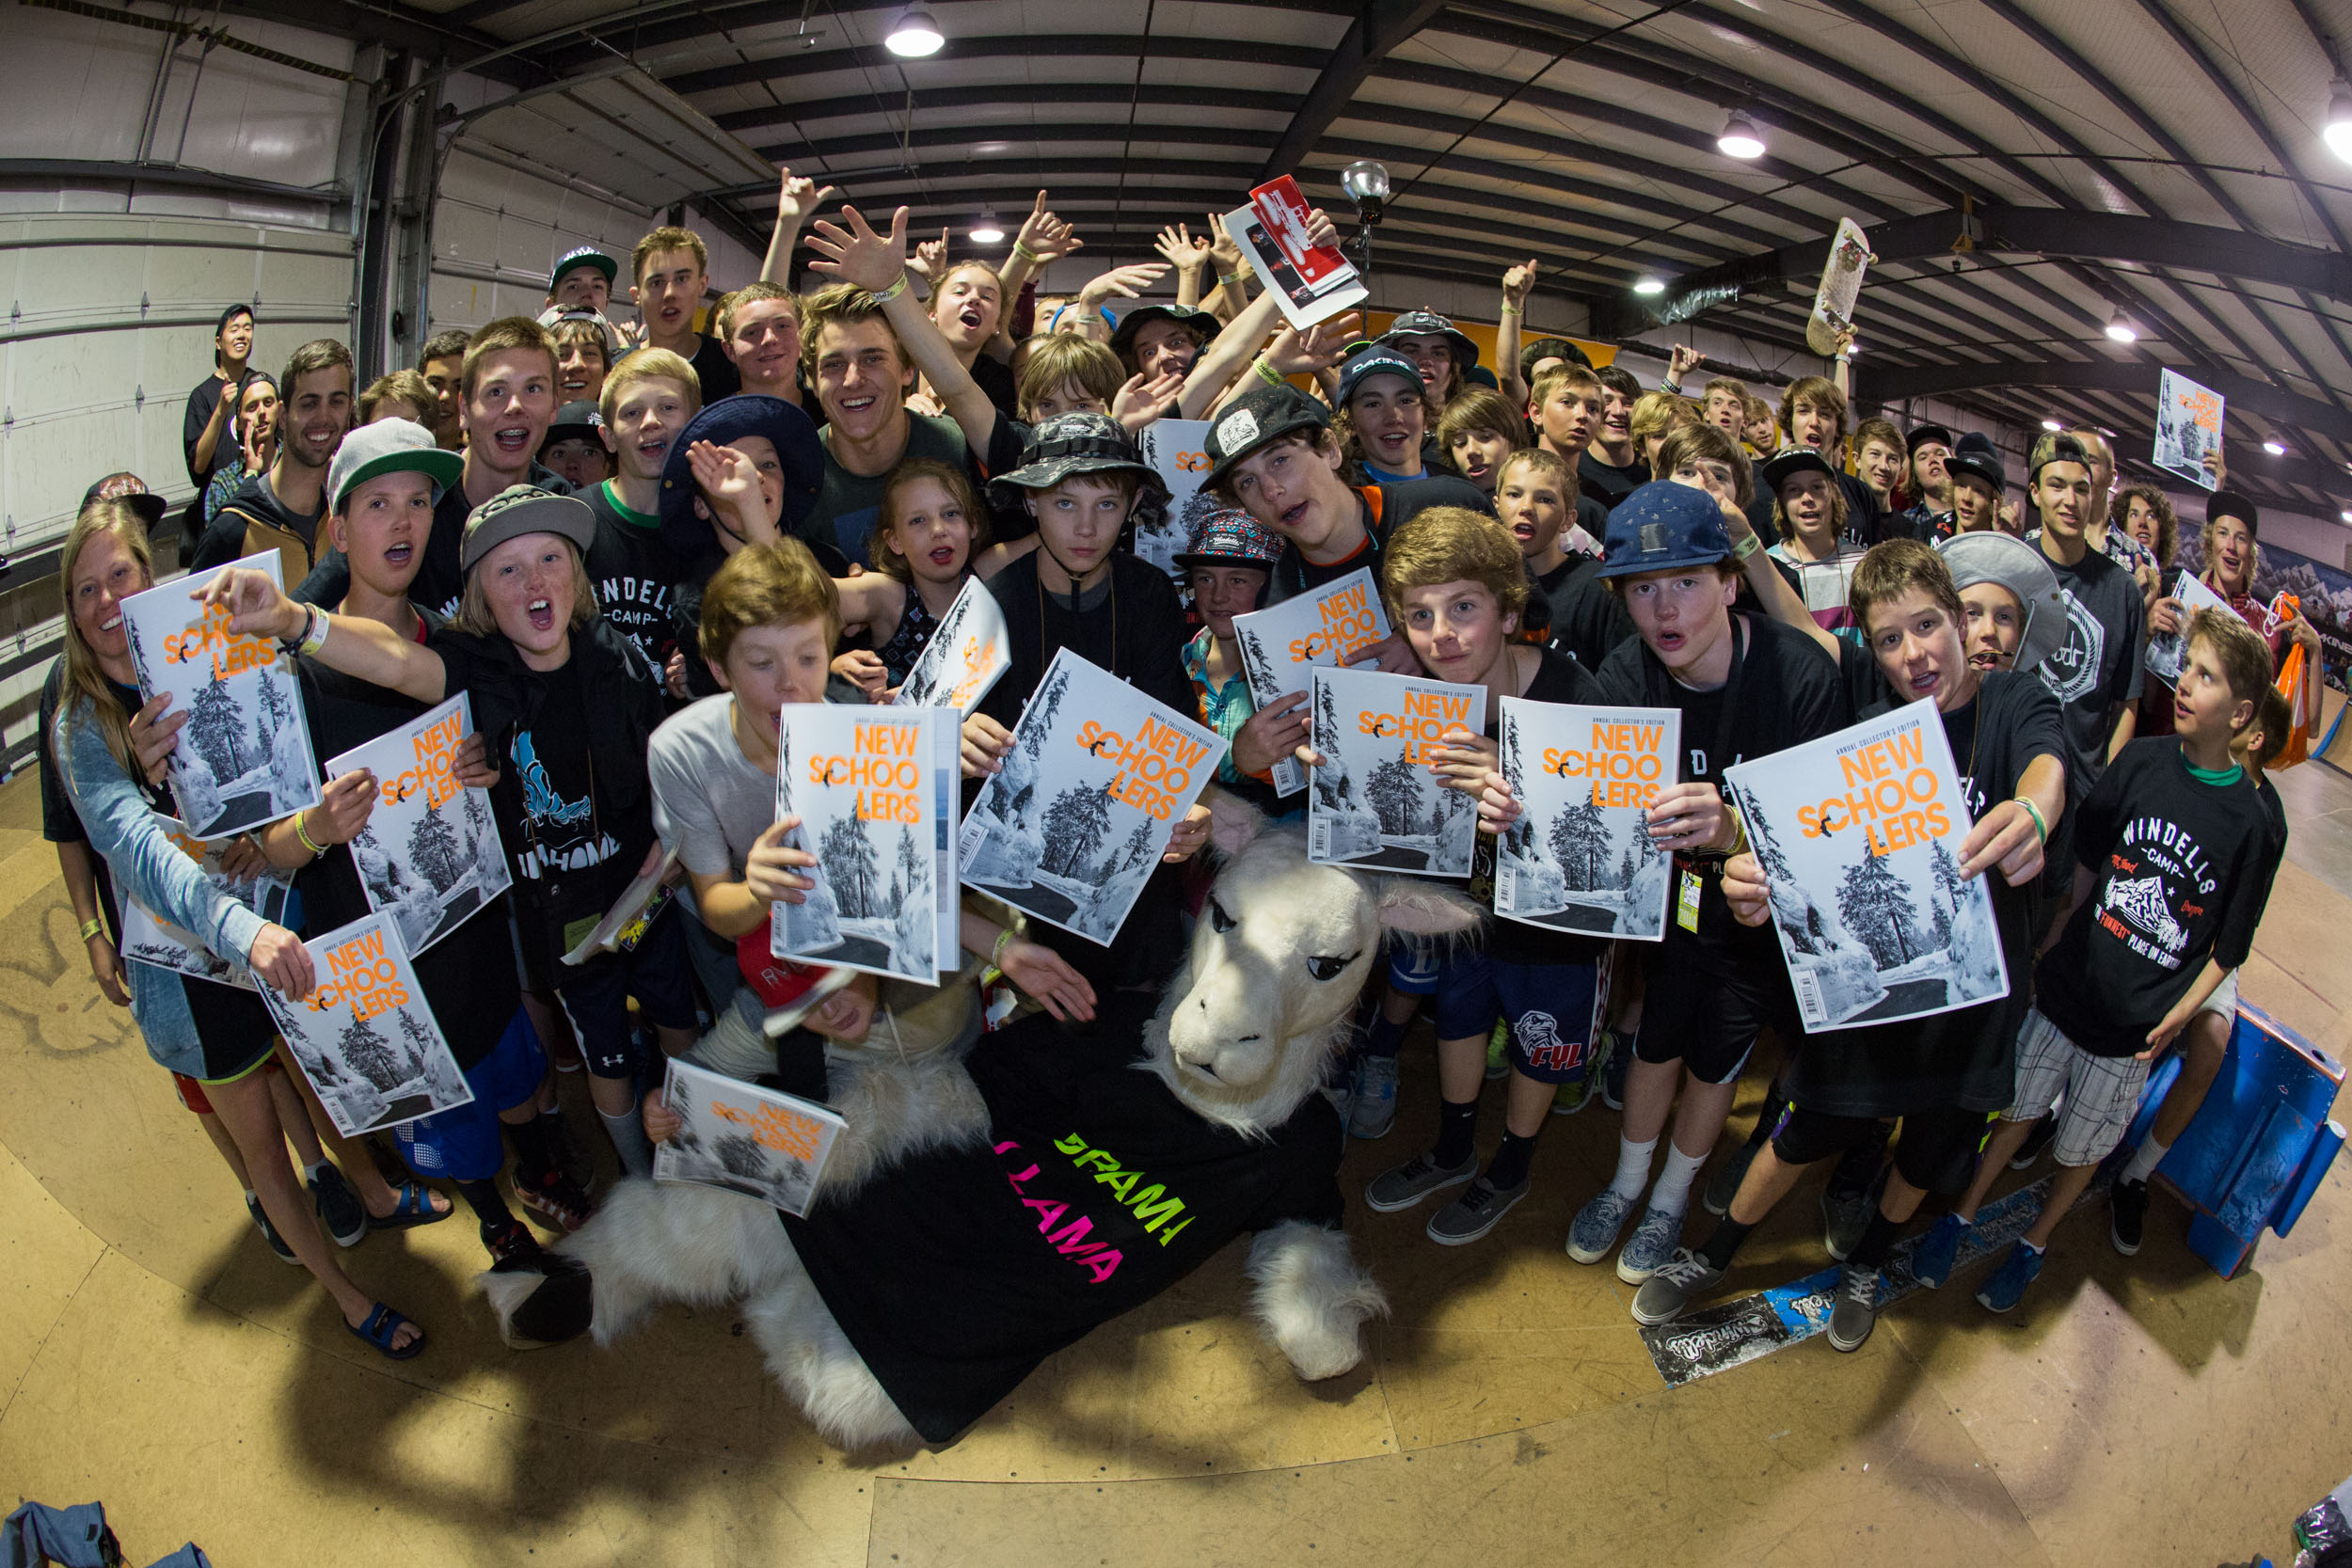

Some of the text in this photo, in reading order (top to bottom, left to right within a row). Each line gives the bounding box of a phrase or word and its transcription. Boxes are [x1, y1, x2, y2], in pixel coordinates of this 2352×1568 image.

[2196, 389, 2219, 409] NEW
[2195, 413, 2217, 433] LERS
[1318, 583, 1367, 625] NEW
[1289, 609, 1375, 663] SCHOO
[212, 637, 276, 682] LERS
[1404, 691, 1471, 721] NEW
[412, 711, 461, 762] NEW
[855, 723, 919, 756] NEW
[1136, 716, 1209, 770] NEW
[1150, 710, 1213, 749] ANNUAL COLLECTOR'S EDITION
[1592, 723, 1663, 752] NEW
[1836, 719, 1920, 755] ANNUAL COLLECTOR'S EDITION
[809, 753, 920, 790] SCHOO
[1076, 720, 1190, 794] SCHOO
[1543, 748, 1662, 781] SCHOO
[1838, 727, 1924, 788] NEW
[426, 769, 464, 812] LER
[856, 789, 921, 823] LERS
[1106, 769, 1177, 821] LERS
[1592, 780, 1661, 810] LERS
[1797, 768, 1939, 839] SCHOO
[1865, 801, 1950, 858] LERS
[2122, 816, 2217, 895] WINDELLS
[1678, 909, 1697, 928] 2014
[326, 929, 385, 976] NEW
[2127, 934, 2151, 957] PLACE
[2147, 946, 2161, 960] ON
[304, 958, 397, 1013] SCHOO
[350, 981, 409, 1023] LERS
[710, 1100, 819, 1147] SCHOO
[757, 1101, 825, 1136] NEW
[754, 1127, 815, 1161] LERS
